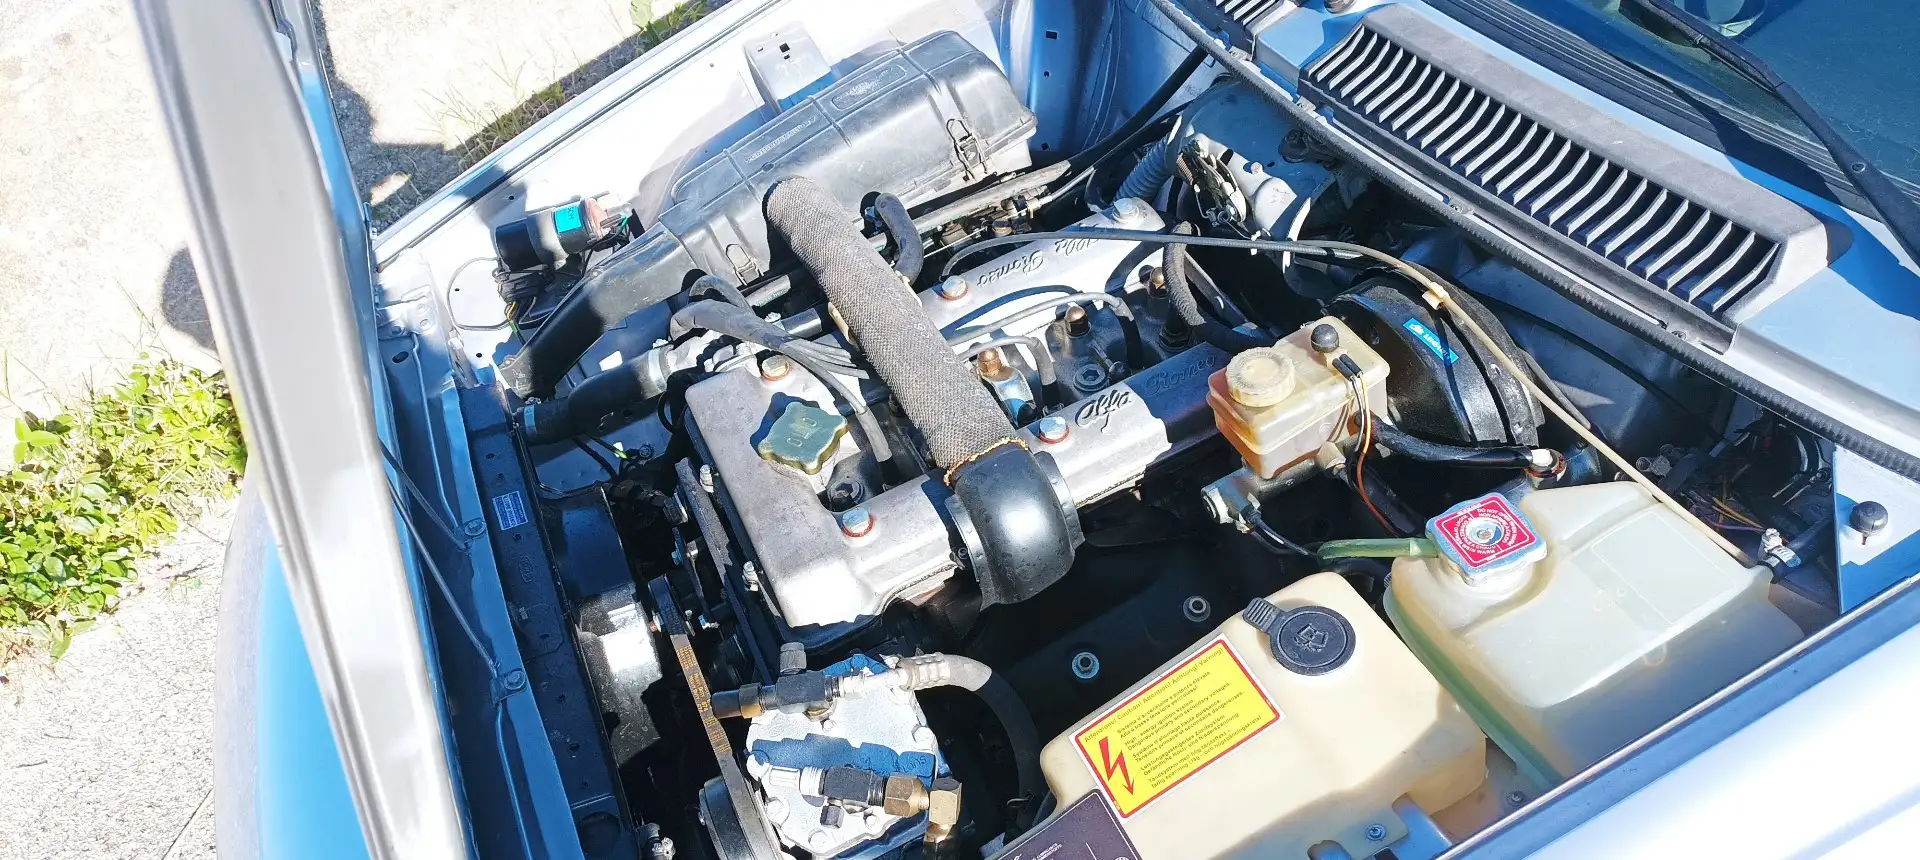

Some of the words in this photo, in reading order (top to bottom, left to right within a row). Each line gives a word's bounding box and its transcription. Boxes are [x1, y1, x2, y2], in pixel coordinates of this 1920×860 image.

[977, 250, 1044, 287] Romeo
[1075, 389, 1132, 434] Alfa
[1144, 354, 1217, 396] Romeo
[1116, 700, 1142, 720] Caution!
[1142, 681, 1172, 704] Attention!
[1170, 663, 1199, 685] Achtung!
[1124, 736, 1137, 747] High
[1139, 723, 1157, 737] energy
[1156, 710, 1176, 725] ignition
[1127, 731, 1154, 751] Dangerous
[1183, 695, 1209, 715] secondary
